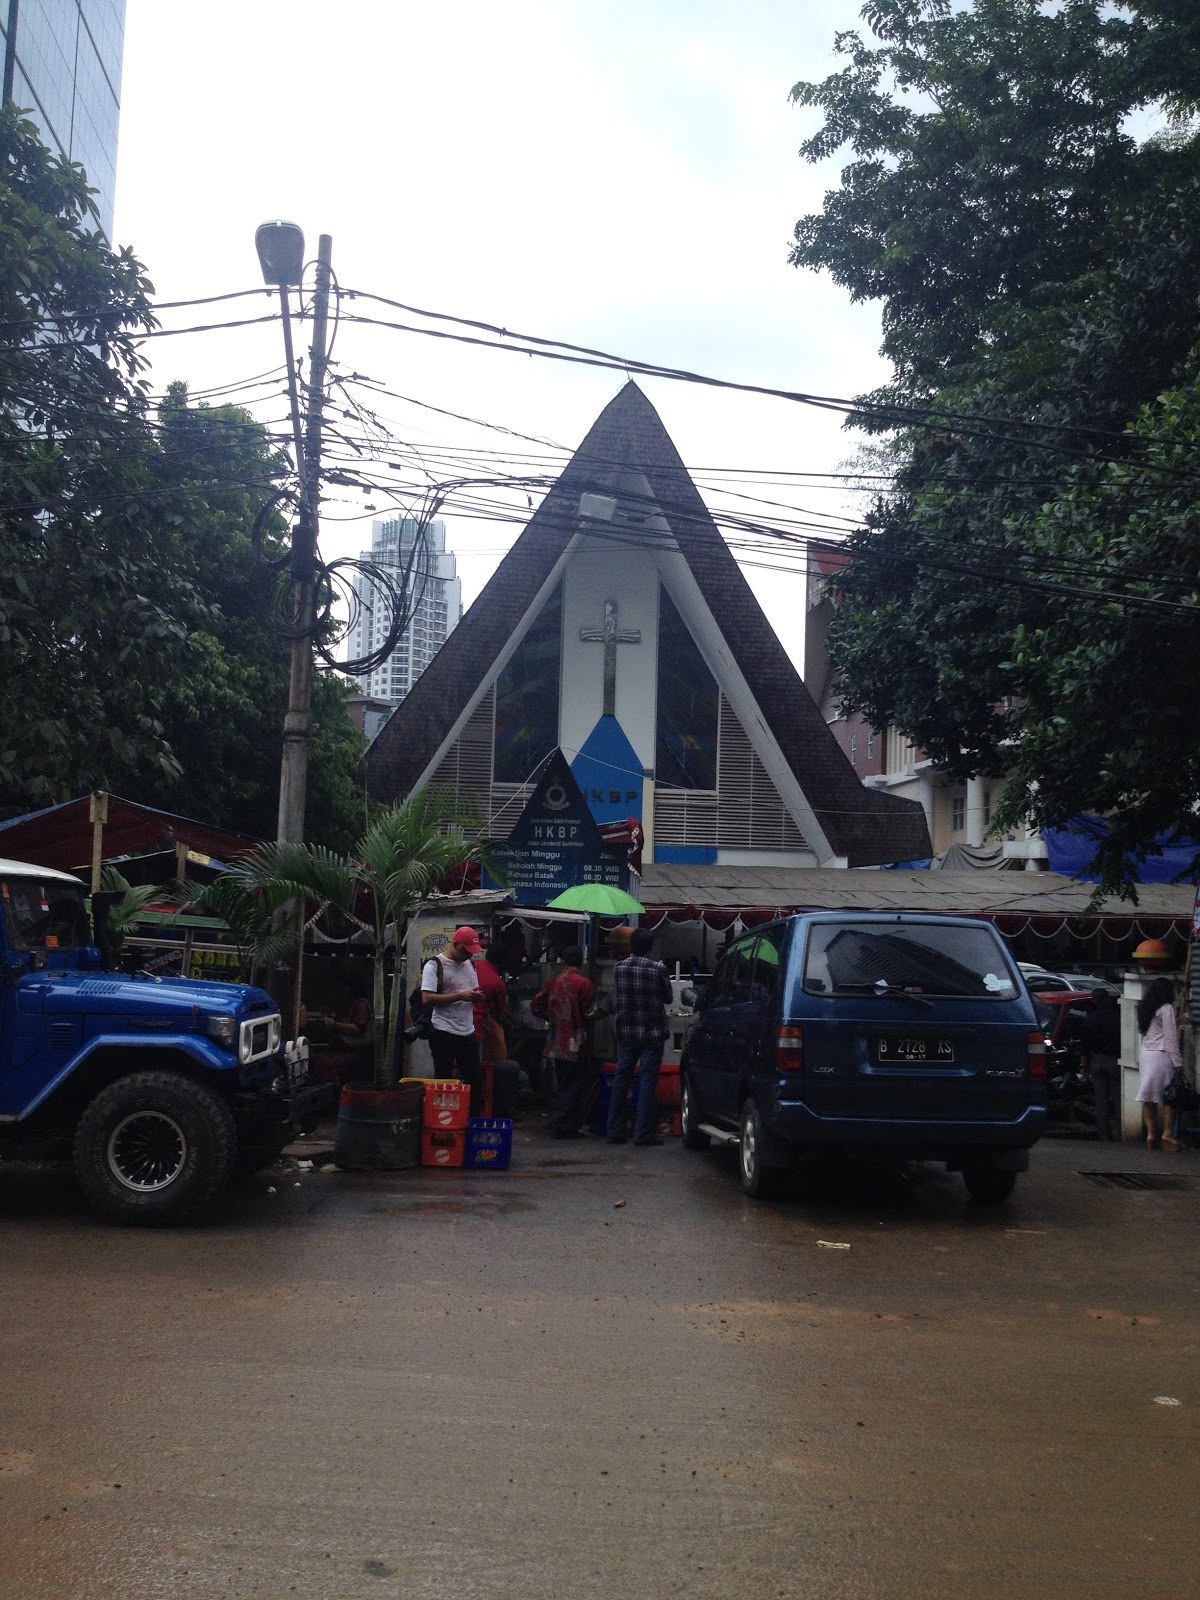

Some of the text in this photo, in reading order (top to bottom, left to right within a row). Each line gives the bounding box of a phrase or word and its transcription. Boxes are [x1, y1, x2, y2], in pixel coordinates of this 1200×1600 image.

[534, 826, 577, 838] HKBP
[531, 850, 561, 859] Minggu
[507, 862, 535, 870] Sekolah
[536, 863, 563, 872] Minggu
[507, 871, 533, 879] Bahasa
[534, 881, 568, 889] Indonesia
[880, 1039, 952, 1054] B 2728 XS
